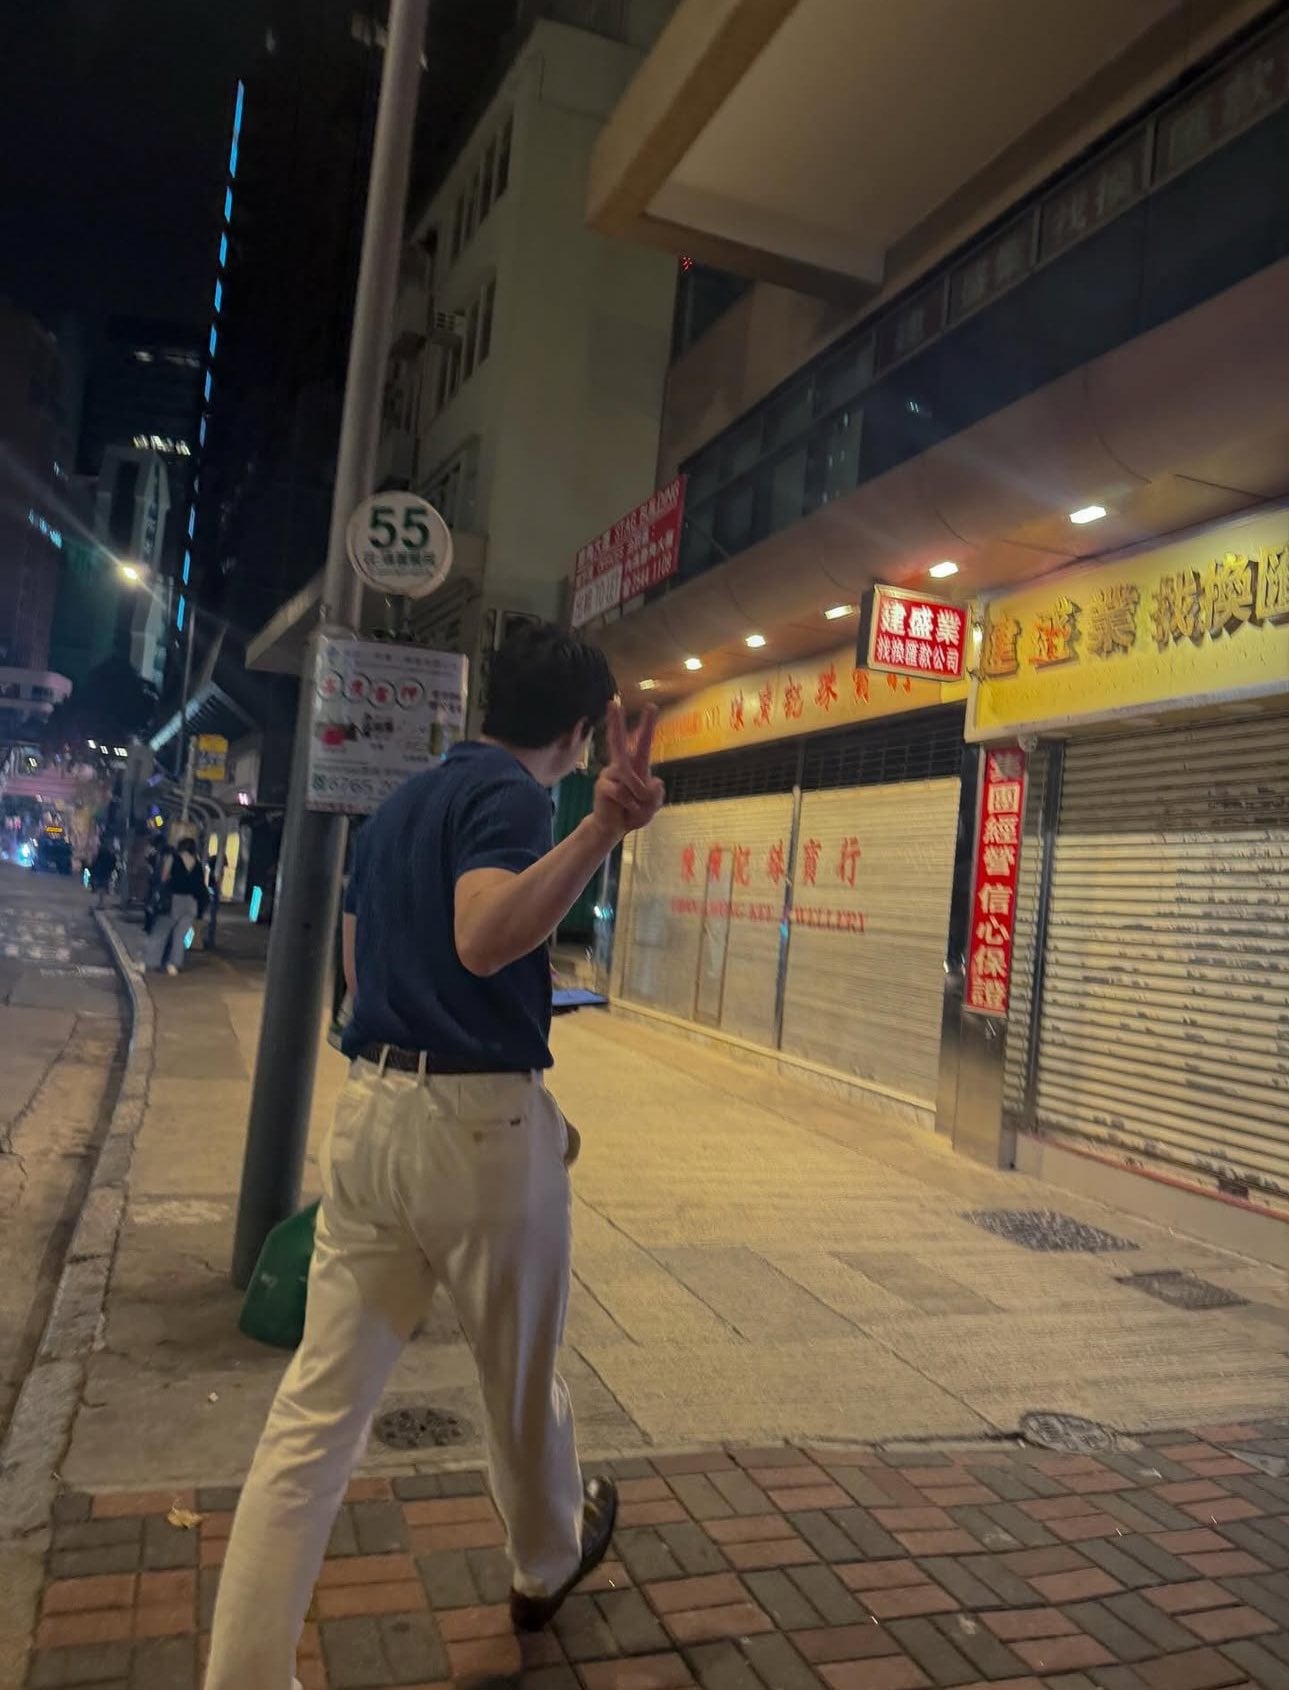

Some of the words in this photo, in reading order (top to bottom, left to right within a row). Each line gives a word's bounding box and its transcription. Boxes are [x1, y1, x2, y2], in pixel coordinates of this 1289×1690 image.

[368, 505, 430, 550] 55
[879, 599, 962, 646] 建盛業
[875, 633, 960, 675] 找換匯款公司
